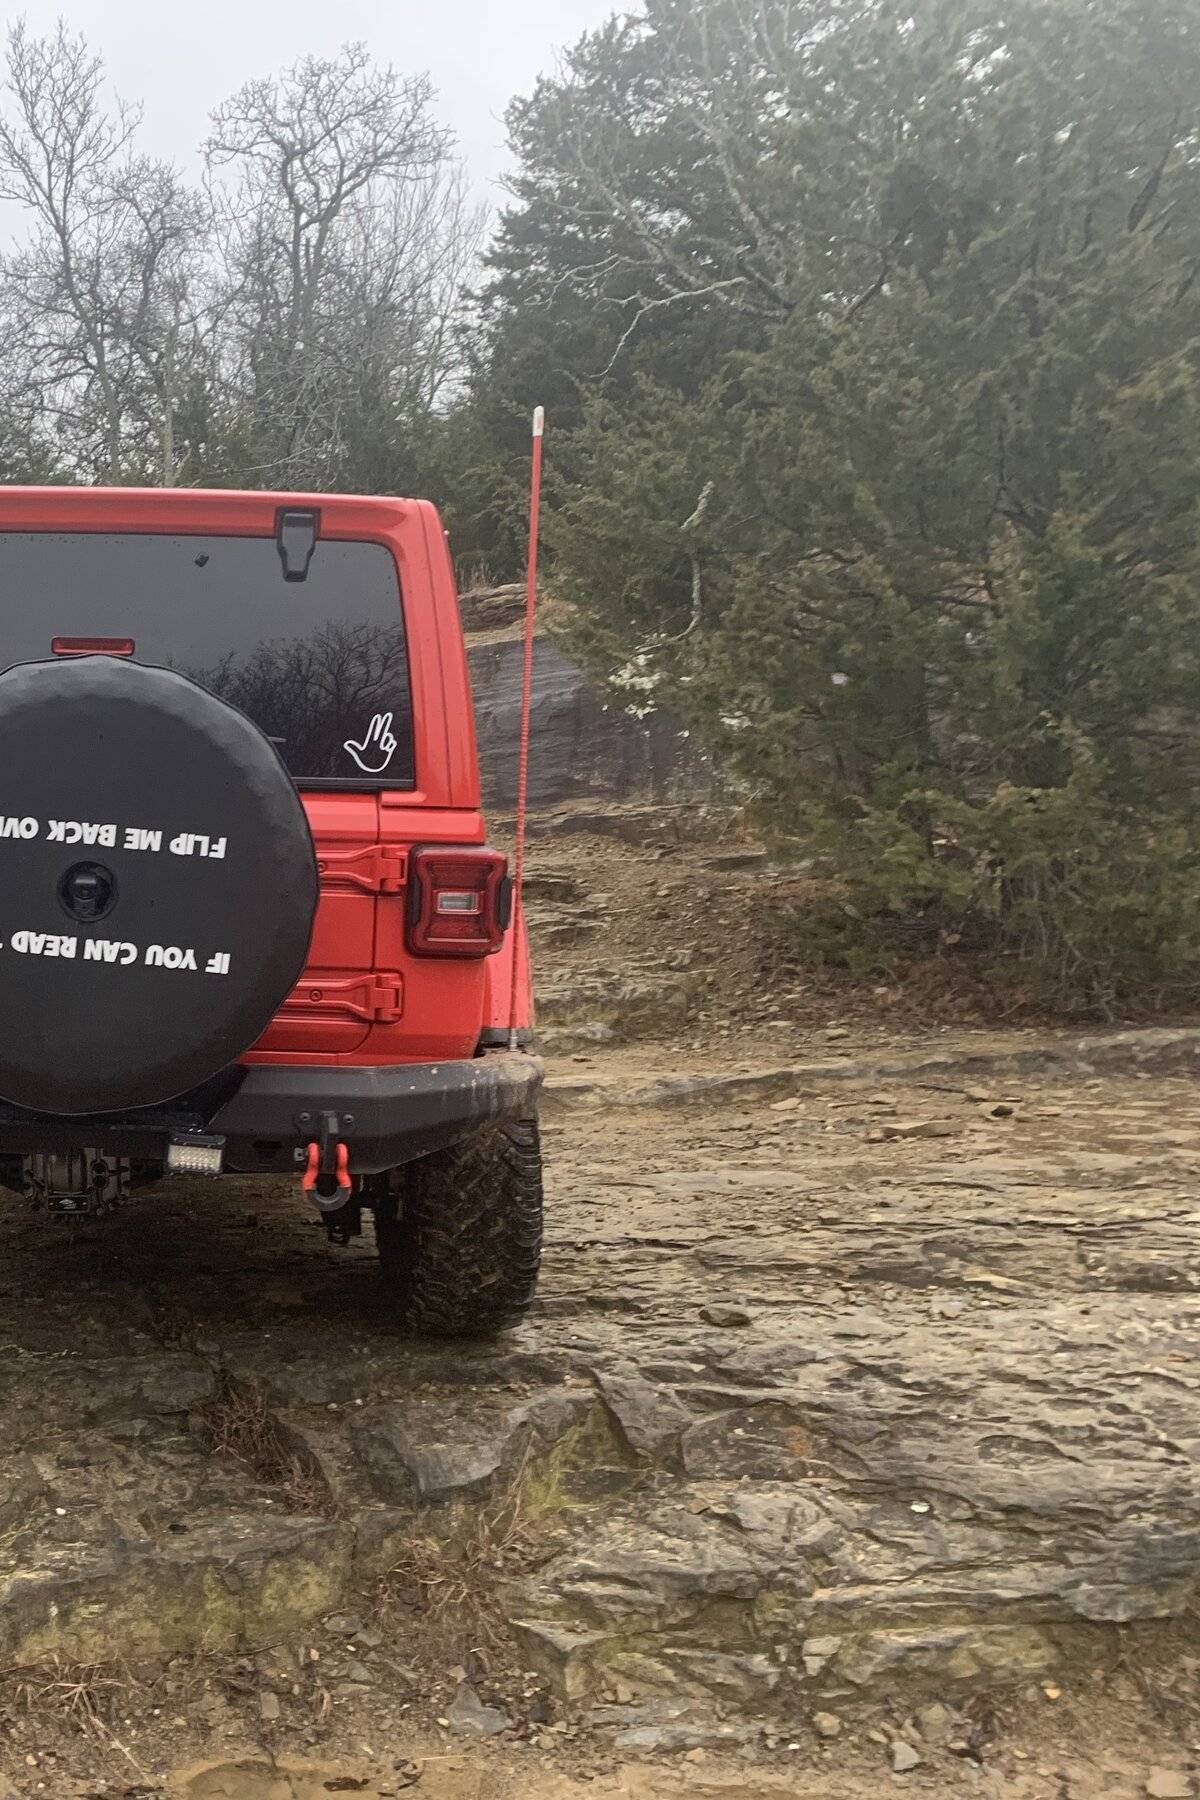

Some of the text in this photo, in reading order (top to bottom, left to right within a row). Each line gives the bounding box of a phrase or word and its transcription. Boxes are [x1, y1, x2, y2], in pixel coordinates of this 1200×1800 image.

[46, 820, 117, 847] BACK
[123, 827, 163, 852] ME
[169, 832, 227, 859] FLIP
[10, 930, 78, 958] READ
[83, 938, 138, 965] CAN
[144, 944, 198, 970] YOU
[204, 952, 231, 975] IF
